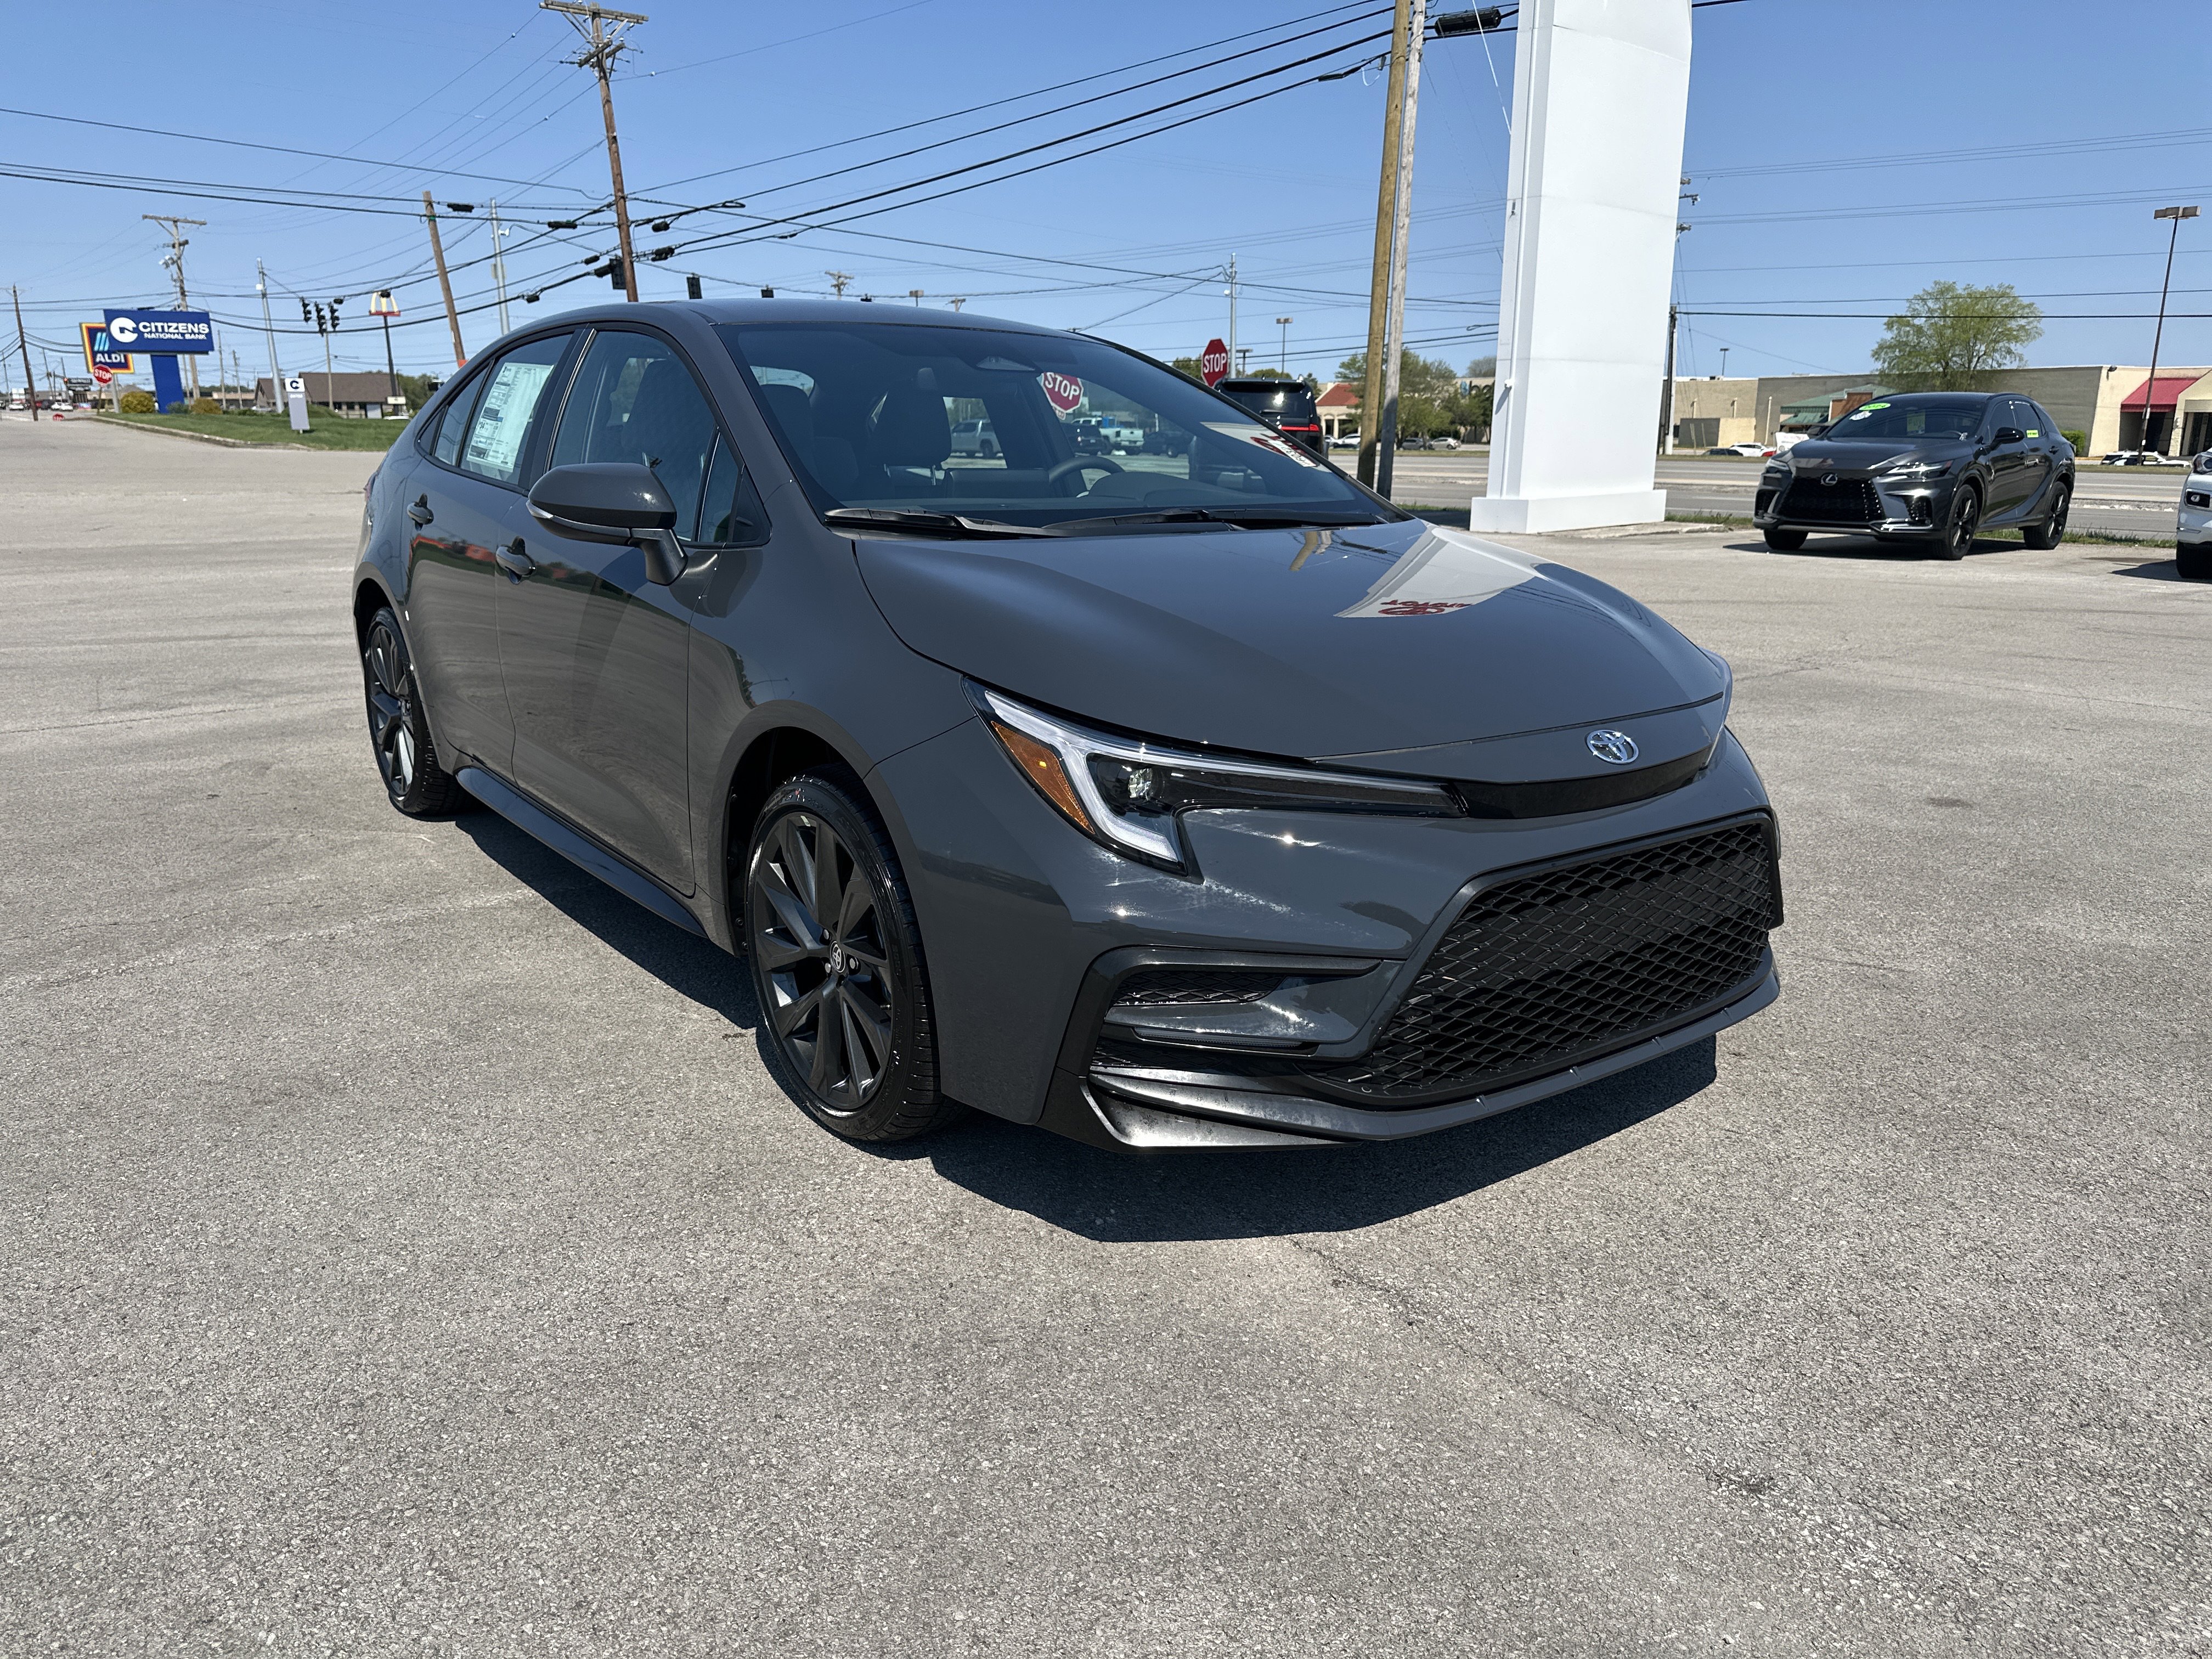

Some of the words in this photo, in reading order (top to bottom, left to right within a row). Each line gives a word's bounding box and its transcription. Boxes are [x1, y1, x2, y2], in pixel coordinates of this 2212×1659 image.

[139, 321, 209, 334] CITIZENS
[95, 353, 125, 363] ALDI
[1204, 353, 1227, 374] STOP
[94, 369, 112, 381] STOP
[1045, 372, 1080, 400] STOP
